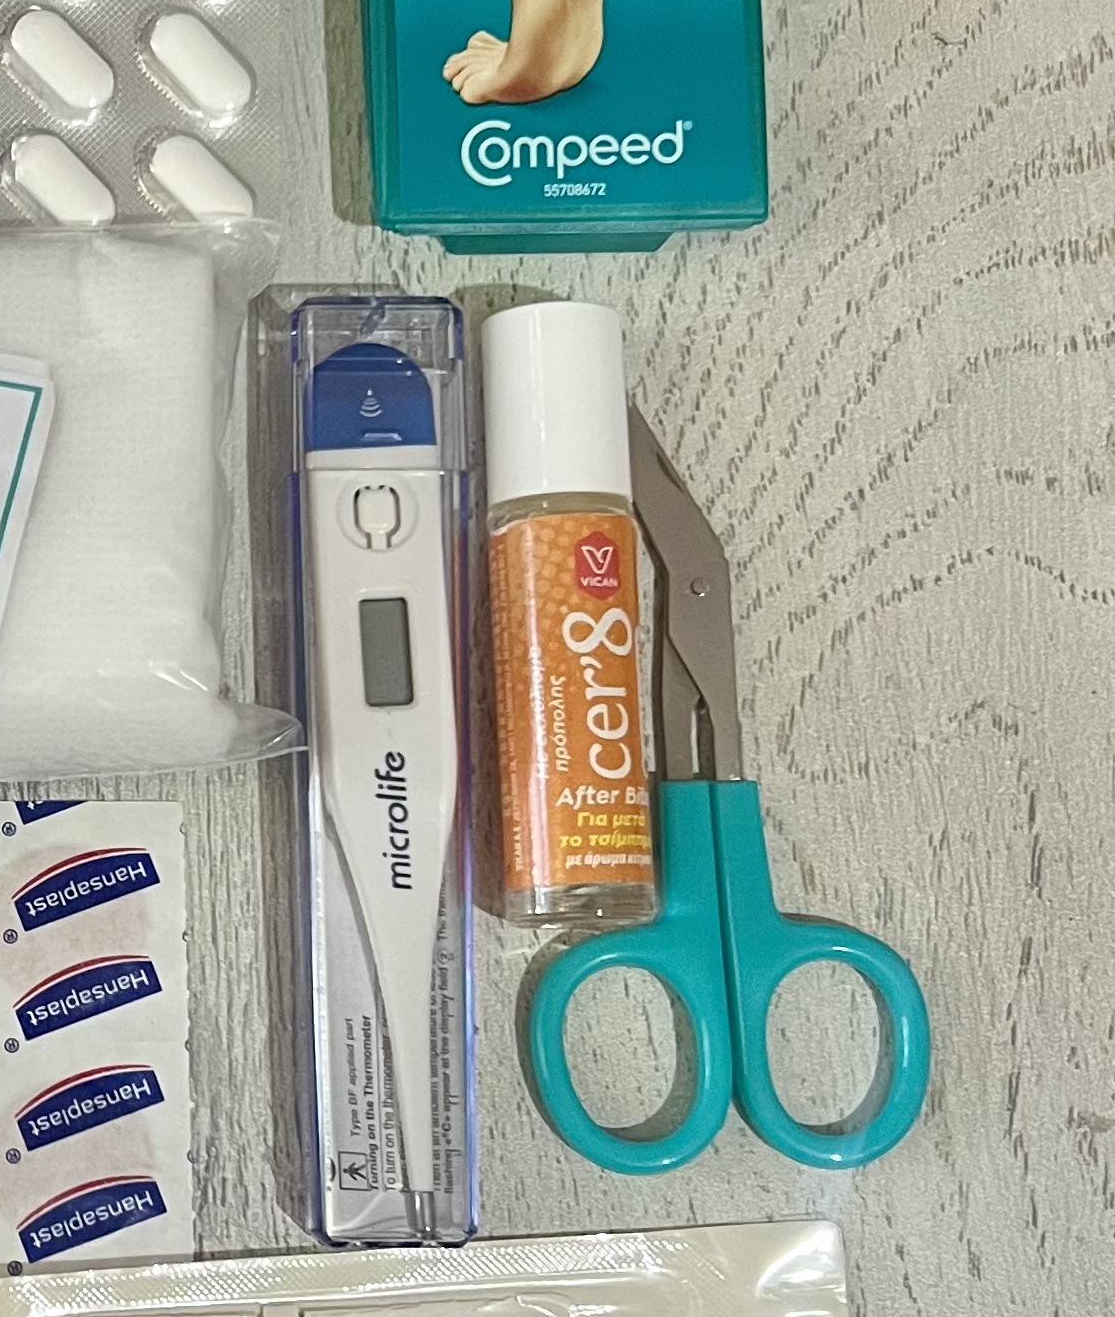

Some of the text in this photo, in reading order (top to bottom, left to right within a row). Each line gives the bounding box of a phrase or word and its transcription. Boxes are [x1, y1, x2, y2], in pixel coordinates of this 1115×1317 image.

[461, 120, 683, 186] Compeed
[580, 577, 617, 587] VICAN
[376, 750, 414, 890] microlife
[556, 786, 619, 810] After
[27, 862, 148, 917] Hansaplast
[27, 969, 150, 1027] Hansaplast
[29, 1080, 153, 1138] Hansaplast
[30, 1191, 154, 1249] Hansaplast
